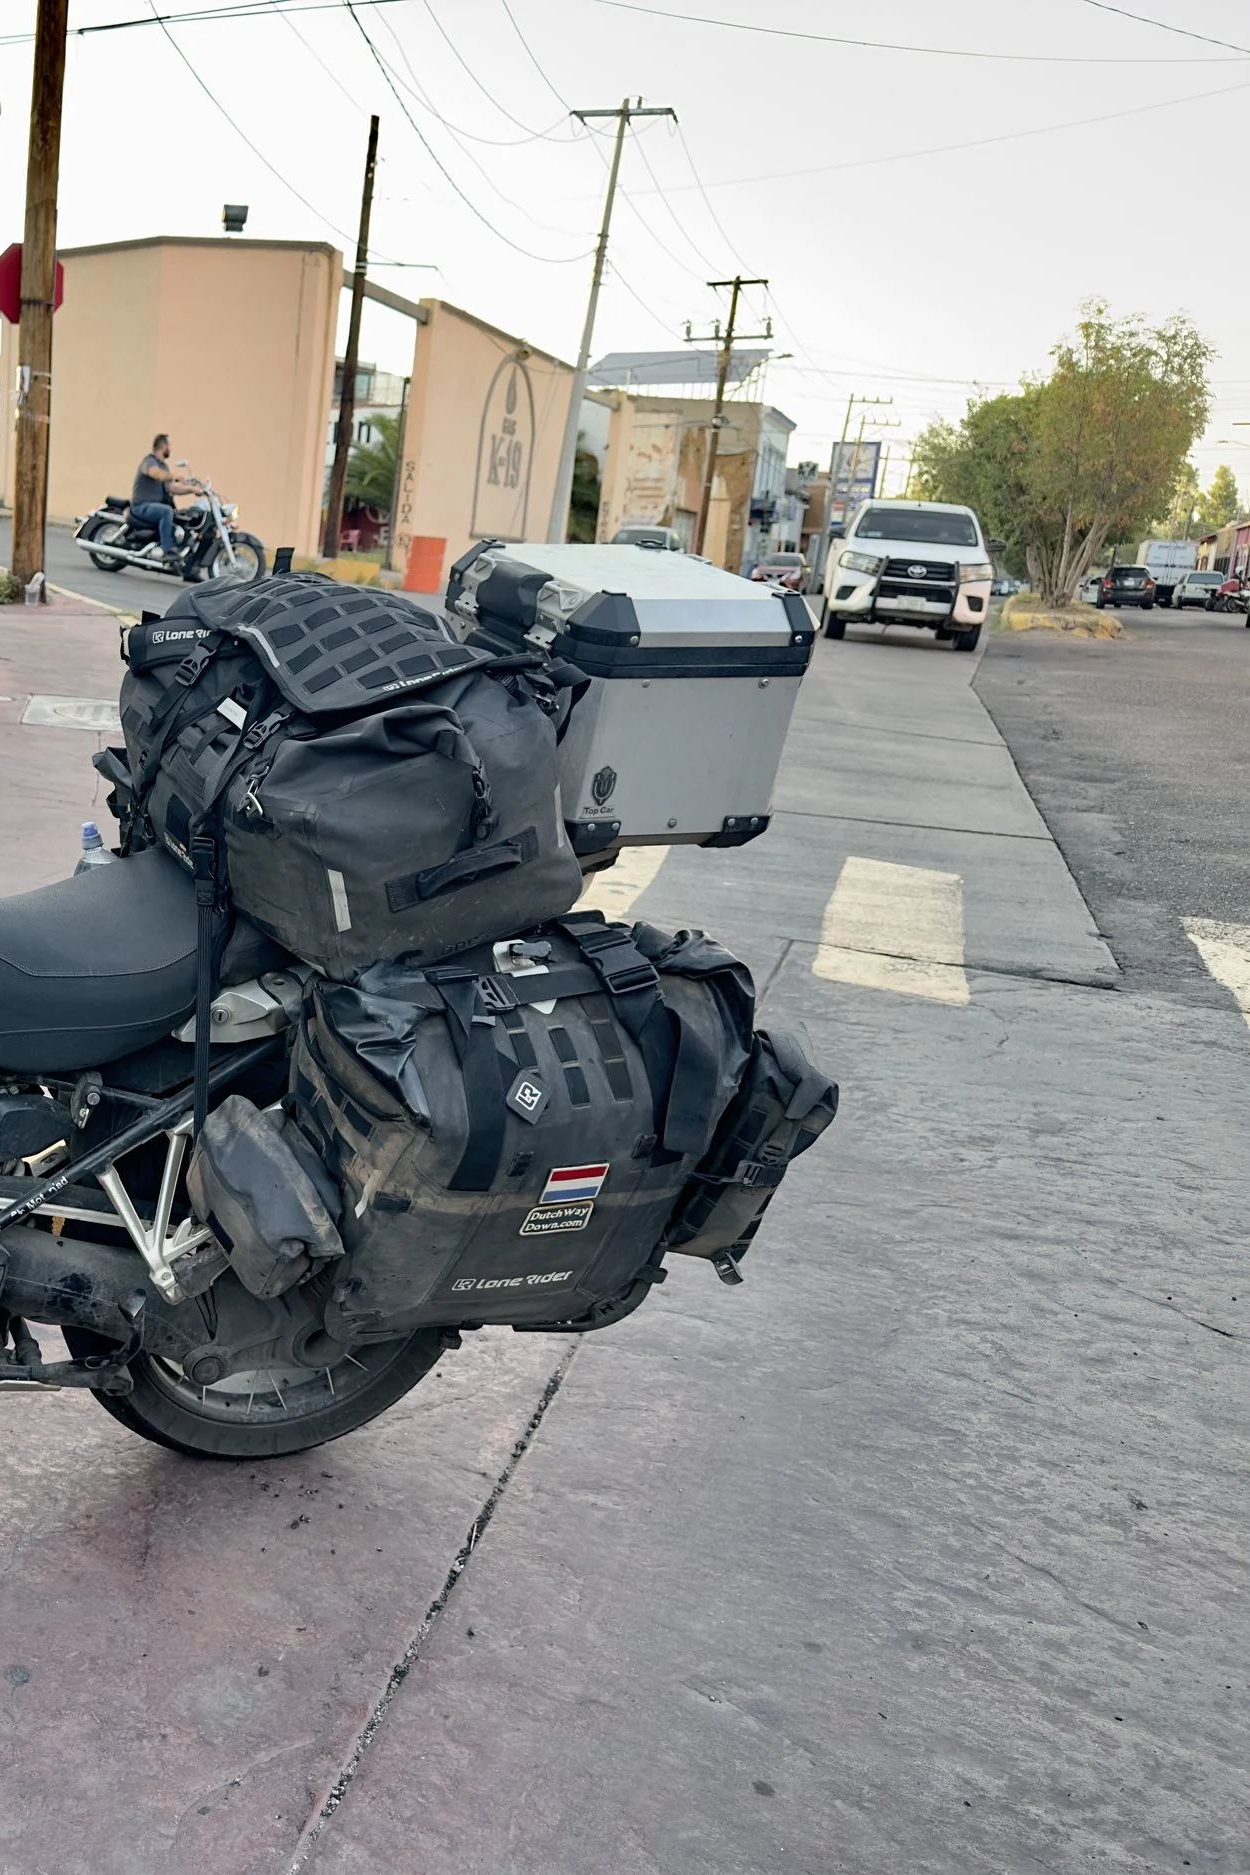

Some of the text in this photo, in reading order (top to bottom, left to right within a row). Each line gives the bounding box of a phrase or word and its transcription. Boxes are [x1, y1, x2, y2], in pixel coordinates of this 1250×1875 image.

[487, 433, 522, 489] K-19
[401, 460, 416, 525] SALIDA
[165, 630, 195, 641] Lone
[517, 1083, 540, 1109] LR
[525, 1219, 583, 1232] Down.com
[476, 1276, 523, 1290] Lone
[525, 1270, 574, 1285] Rider
